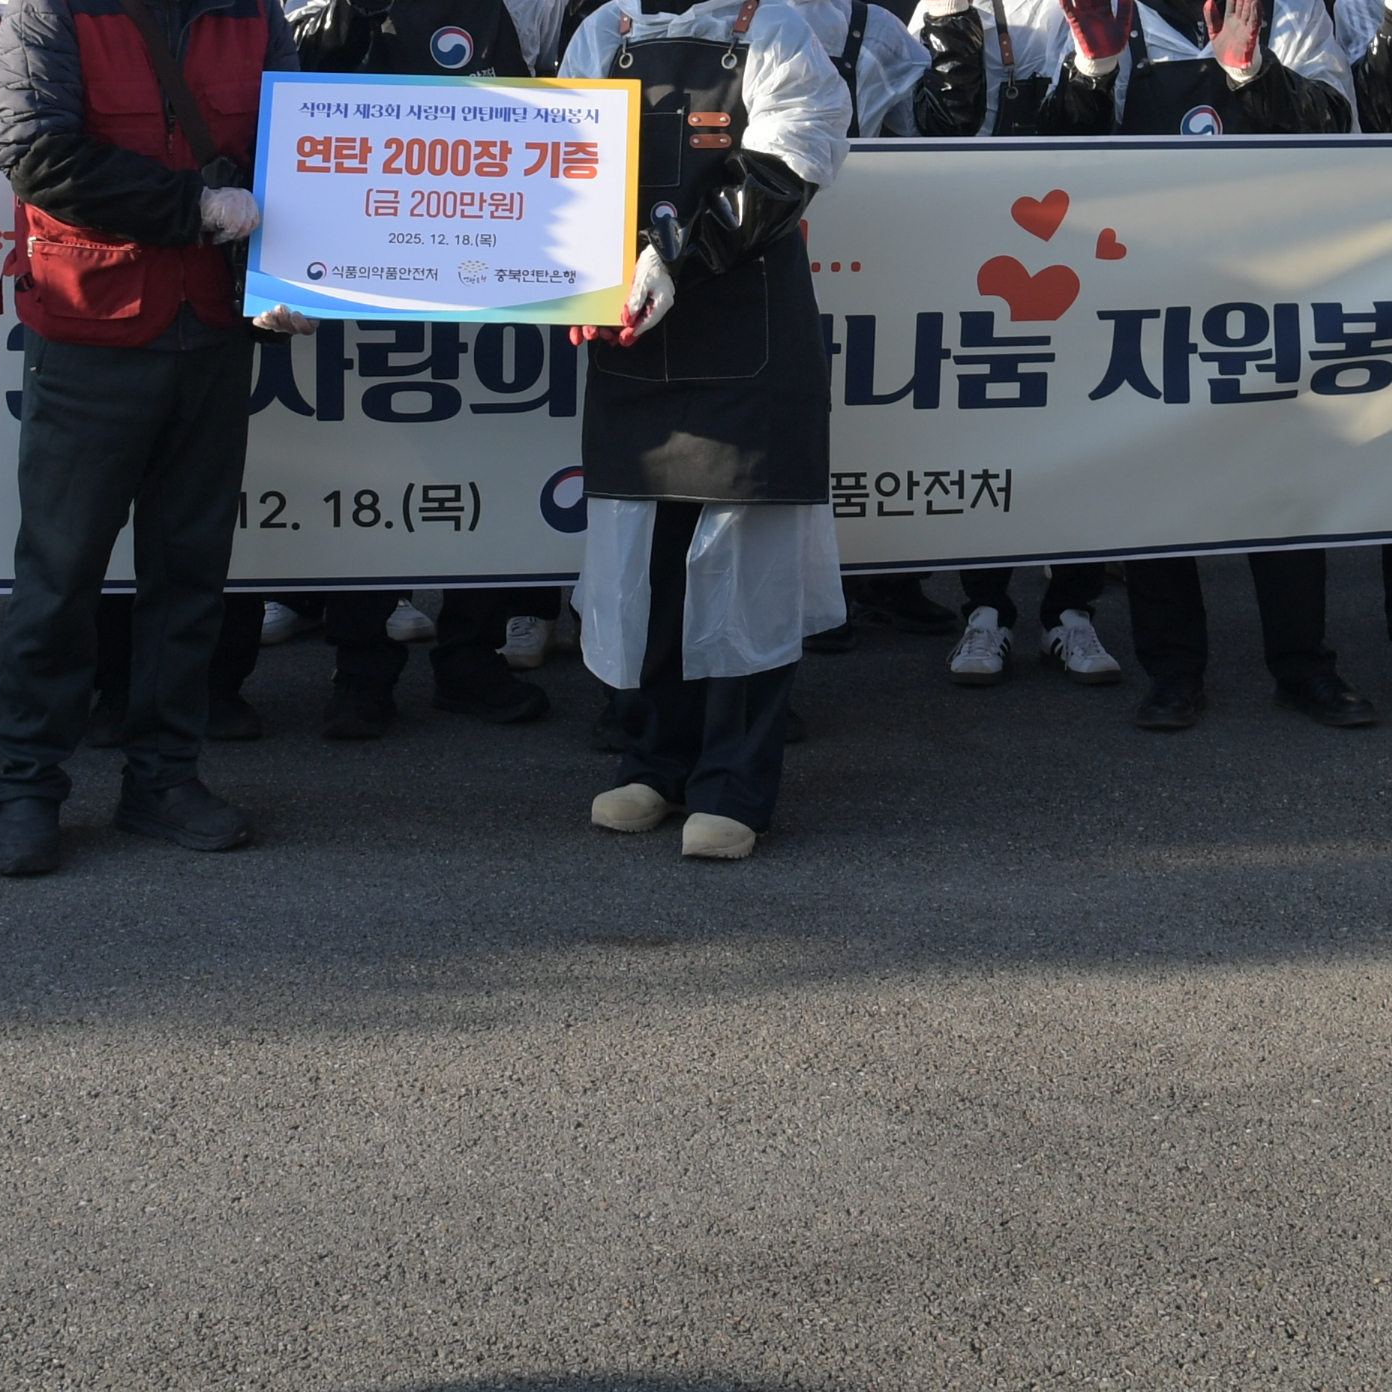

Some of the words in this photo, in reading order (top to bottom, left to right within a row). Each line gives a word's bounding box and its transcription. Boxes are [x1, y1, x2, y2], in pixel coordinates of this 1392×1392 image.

[353, 103, 401, 119] 제3회
[406, 105, 456, 121] 사랑의
[532, 107, 600, 124] 자원봉사
[296, 136, 372, 175] 연탄
[382, 137, 512, 178] 2000장
[523, 140, 600, 180] 기증
[388, 233, 425, 245] 2025.
[430, 234, 449, 246] 12.
[455, 233, 497, 248] 18.(목)
[331, 264, 439, 282] 식품의약품안전처
[494, 268, 577, 285] 충북연탄은행
[323, 481, 481, 533] 18.(목)
